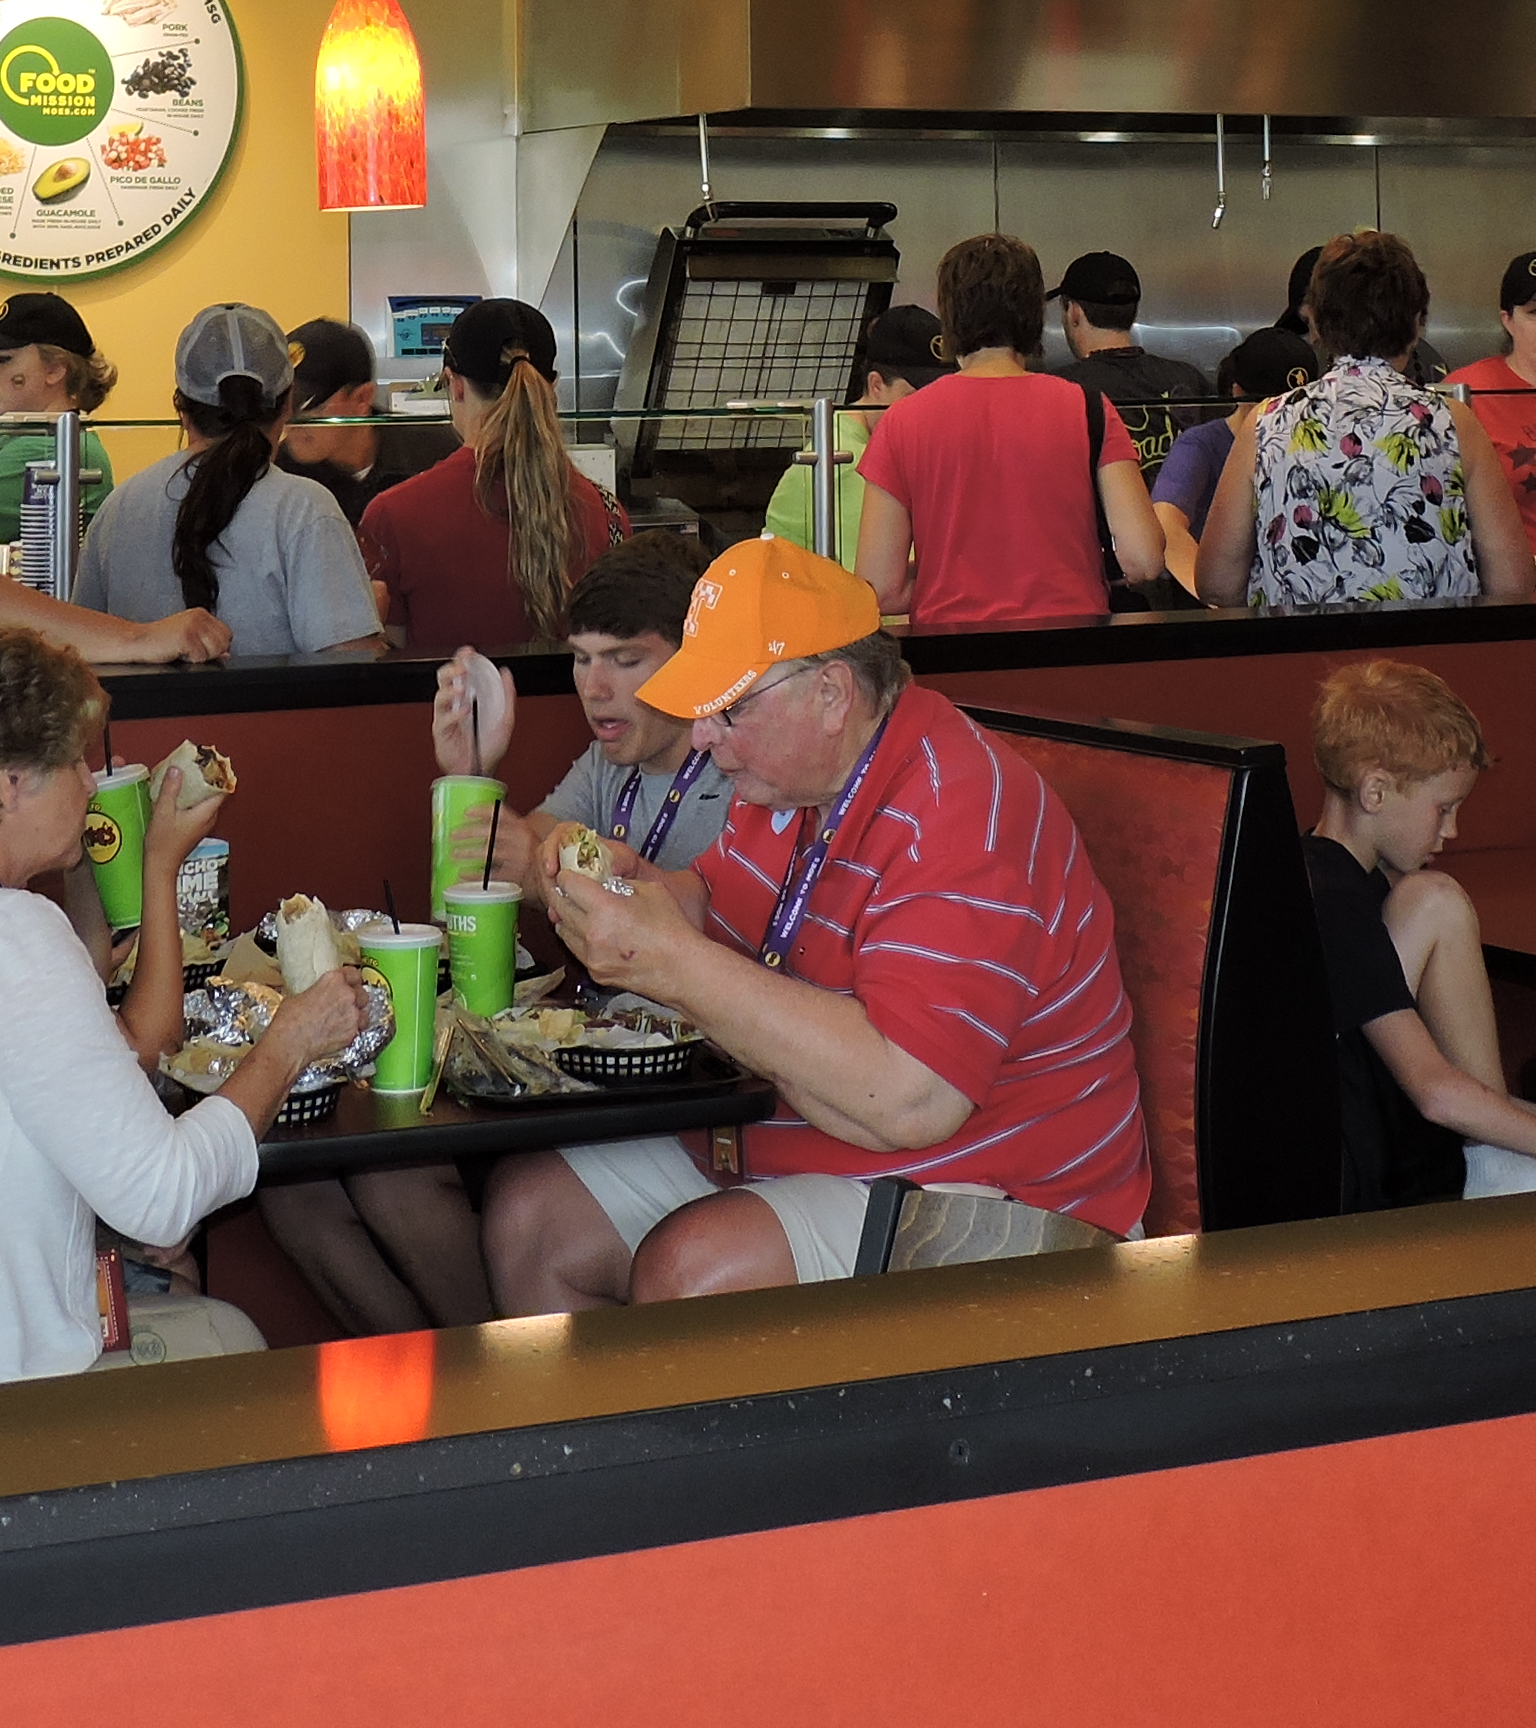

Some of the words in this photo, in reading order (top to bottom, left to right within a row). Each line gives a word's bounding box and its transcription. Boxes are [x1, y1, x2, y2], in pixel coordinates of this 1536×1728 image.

[162, 24, 188, 32] PORK
[19, 72, 96, 94] FOOD
[30, 95, 96, 108] MISSION
[172, 99, 204, 107] BEANS
[42, 107, 96, 116] MOES.COM
[110, 176, 133, 184] PICO
[135, 176, 148, 184] DE
[149, 176, 181, 184] GALLO
[36, 209, 96, 218] GUACAMOLE
[85, 224, 162, 266] PREPARED
[161, 187, 197, 227] DAILY
[693, 669, 758, 715] VOLUNTEERS
[838, 776, 863, 817] WELCOME
[179, 859, 219, 874] CHO
[177, 872, 219, 893] IME
[177, 889, 220, 904] OWL
[780, 897, 803, 939] WELCOME
[800, 882, 809, 896] TO
[808, 856, 821, 881] MOE'S
[448, 913, 477, 932] UTHS
